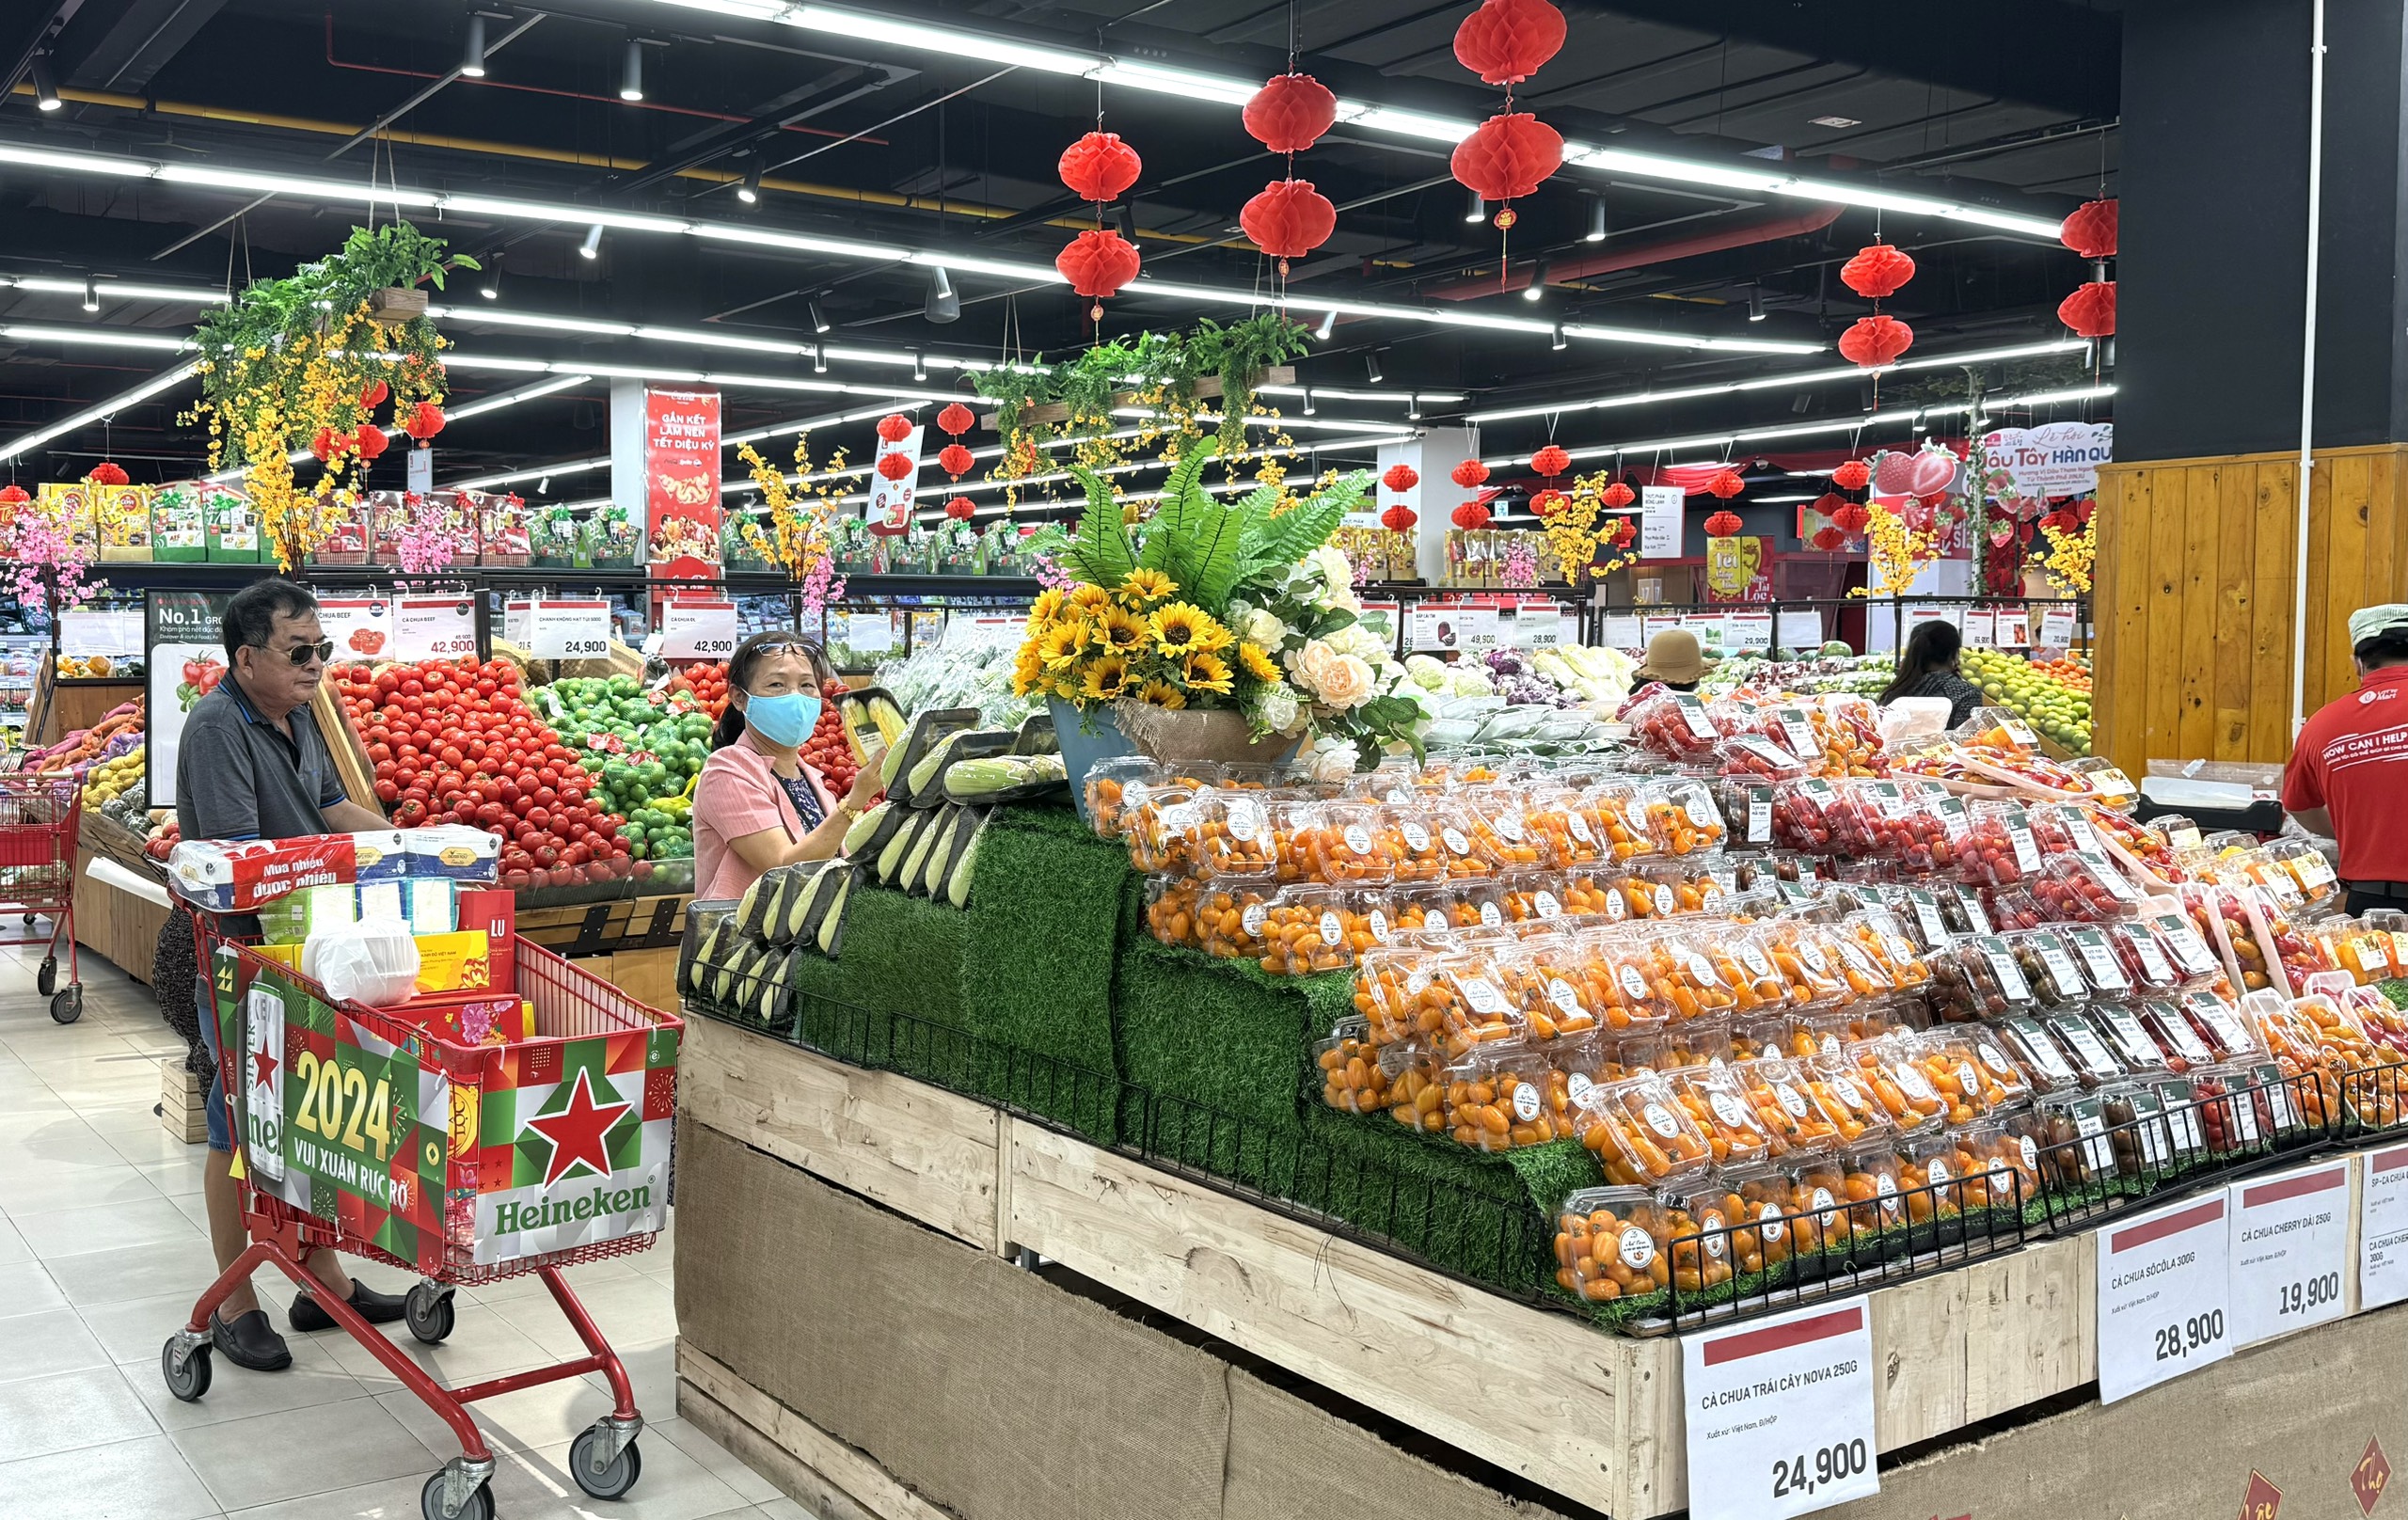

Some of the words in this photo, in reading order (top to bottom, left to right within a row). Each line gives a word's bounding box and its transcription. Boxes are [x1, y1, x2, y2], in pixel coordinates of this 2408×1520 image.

[662, 410, 684, 424] GẮN
[687, 413, 706, 425] KẾT
[653, 436, 673, 448] TẾT
[675, 438, 699, 451] DIỆU
[1982, 451, 2014, 468] âu
[2015, 447, 2049, 467] Tây
[159, 608, 201, 625] No.1
[179, 625, 191, 634] phá
[202, 625, 214, 634] độc
[1471, 634, 1496, 645] 49,900
[1533, 634, 1557, 644] 28,900
[431, 640, 475, 654] 42,900
[565, 641, 607, 655] 24,900
[694, 641, 733, 654] 42,900
[2322, 745, 2345, 760] HOW
[2348, 738, 2373, 751] CAN
[2376, 737, 2380, 746] I
[2383, 732, 2408, 744] HELP
[263, 863, 289, 878] Mua
[293, 856, 325, 872] nhiều
[295, 868, 337, 889] nhiều
[491, 919, 505, 938] LU
[246, 1023, 257, 1092] SILVER
[294, 1050, 391, 1163] 2024
[294, 1136, 316, 1169] VUI
[320, 1148, 356, 1187] XUÂN
[360, 1168, 387, 1201] RỰC
[2390, 1172, 2406, 1183] CHUA
[495, 1185, 651, 1236] Heineken
[2242, 1228, 2253, 1243] CÀ
[2254, 1225, 2273, 1240] CHUA
[2274, 1219, 2303, 1235] CHERRY
[2303, 1213, 2315, 1228] DÀI
[2316, 1211, 2332, 1226] 250G
[2378, 1238, 2394, 1249] CHUA
[2112, 1274, 2123, 1290] CÀ
[2124, 1270, 2146, 1286] CHUA
[2147, 1259, 2177, 1277] SÔCÔLA
[2177, 1251, 2195, 1267] 300G
[2279, 1272, 2339, 1315] 19,900
[2156, 1308, 2224, 1362] 28,900
[1702, 1392, 1718, 1410] CÀ
[1719, 1386, 1751, 1406] CHUA
[1752, 1380, 1778, 1398] TRÁI
[1780, 1373, 1802, 1391] CÂY
[1804, 1368, 1832, 1385] NOVA
[1834, 1360, 1858, 1378] 250G
[1706, 1430, 1720, 1440] Xuất
[1731, 1424, 1744, 1434] Việt
[1744, 1422, 1759, 1432] Nam,
[1759, 1415, 1778, 1428] Đ/HỘP
[1772, 1437, 1867, 1498] 24,900
[2359, 1452, 2384, 1494] Thọ
